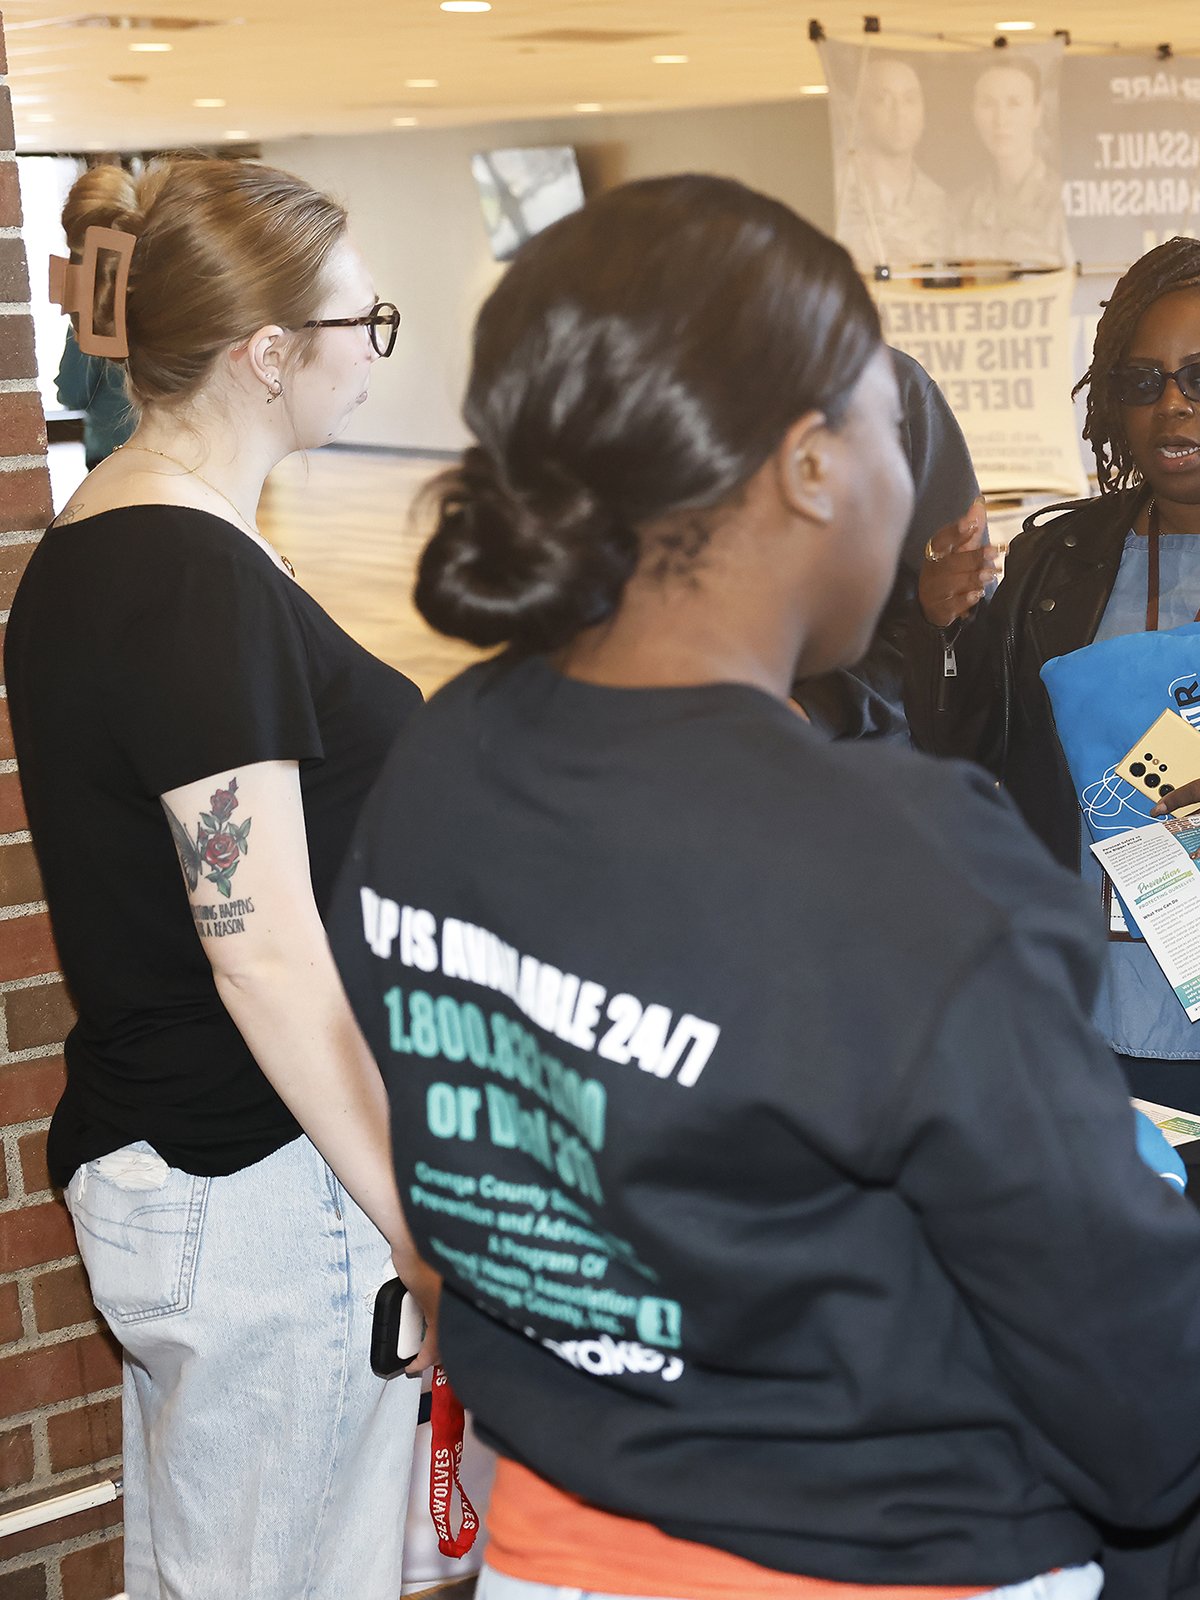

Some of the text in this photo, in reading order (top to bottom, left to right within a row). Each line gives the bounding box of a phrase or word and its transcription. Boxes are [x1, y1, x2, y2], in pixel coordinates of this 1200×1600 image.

[1137, 868, 1181, 894] Prevention
[1139, 877, 1195, 909] PROTECTING OURSELVES
[219, 897, 255, 918] HAPPENS
[1143, 911, 1154, 920] What
[207, 922, 213, 937] A
[213, 918, 245, 937] REASON
[400, 905, 439, 972] IS
[427, 1082, 481, 1141] or
[497, 1211, 535, 1236] and
[433, 1448, 450, 1541] SEAWOLVES
